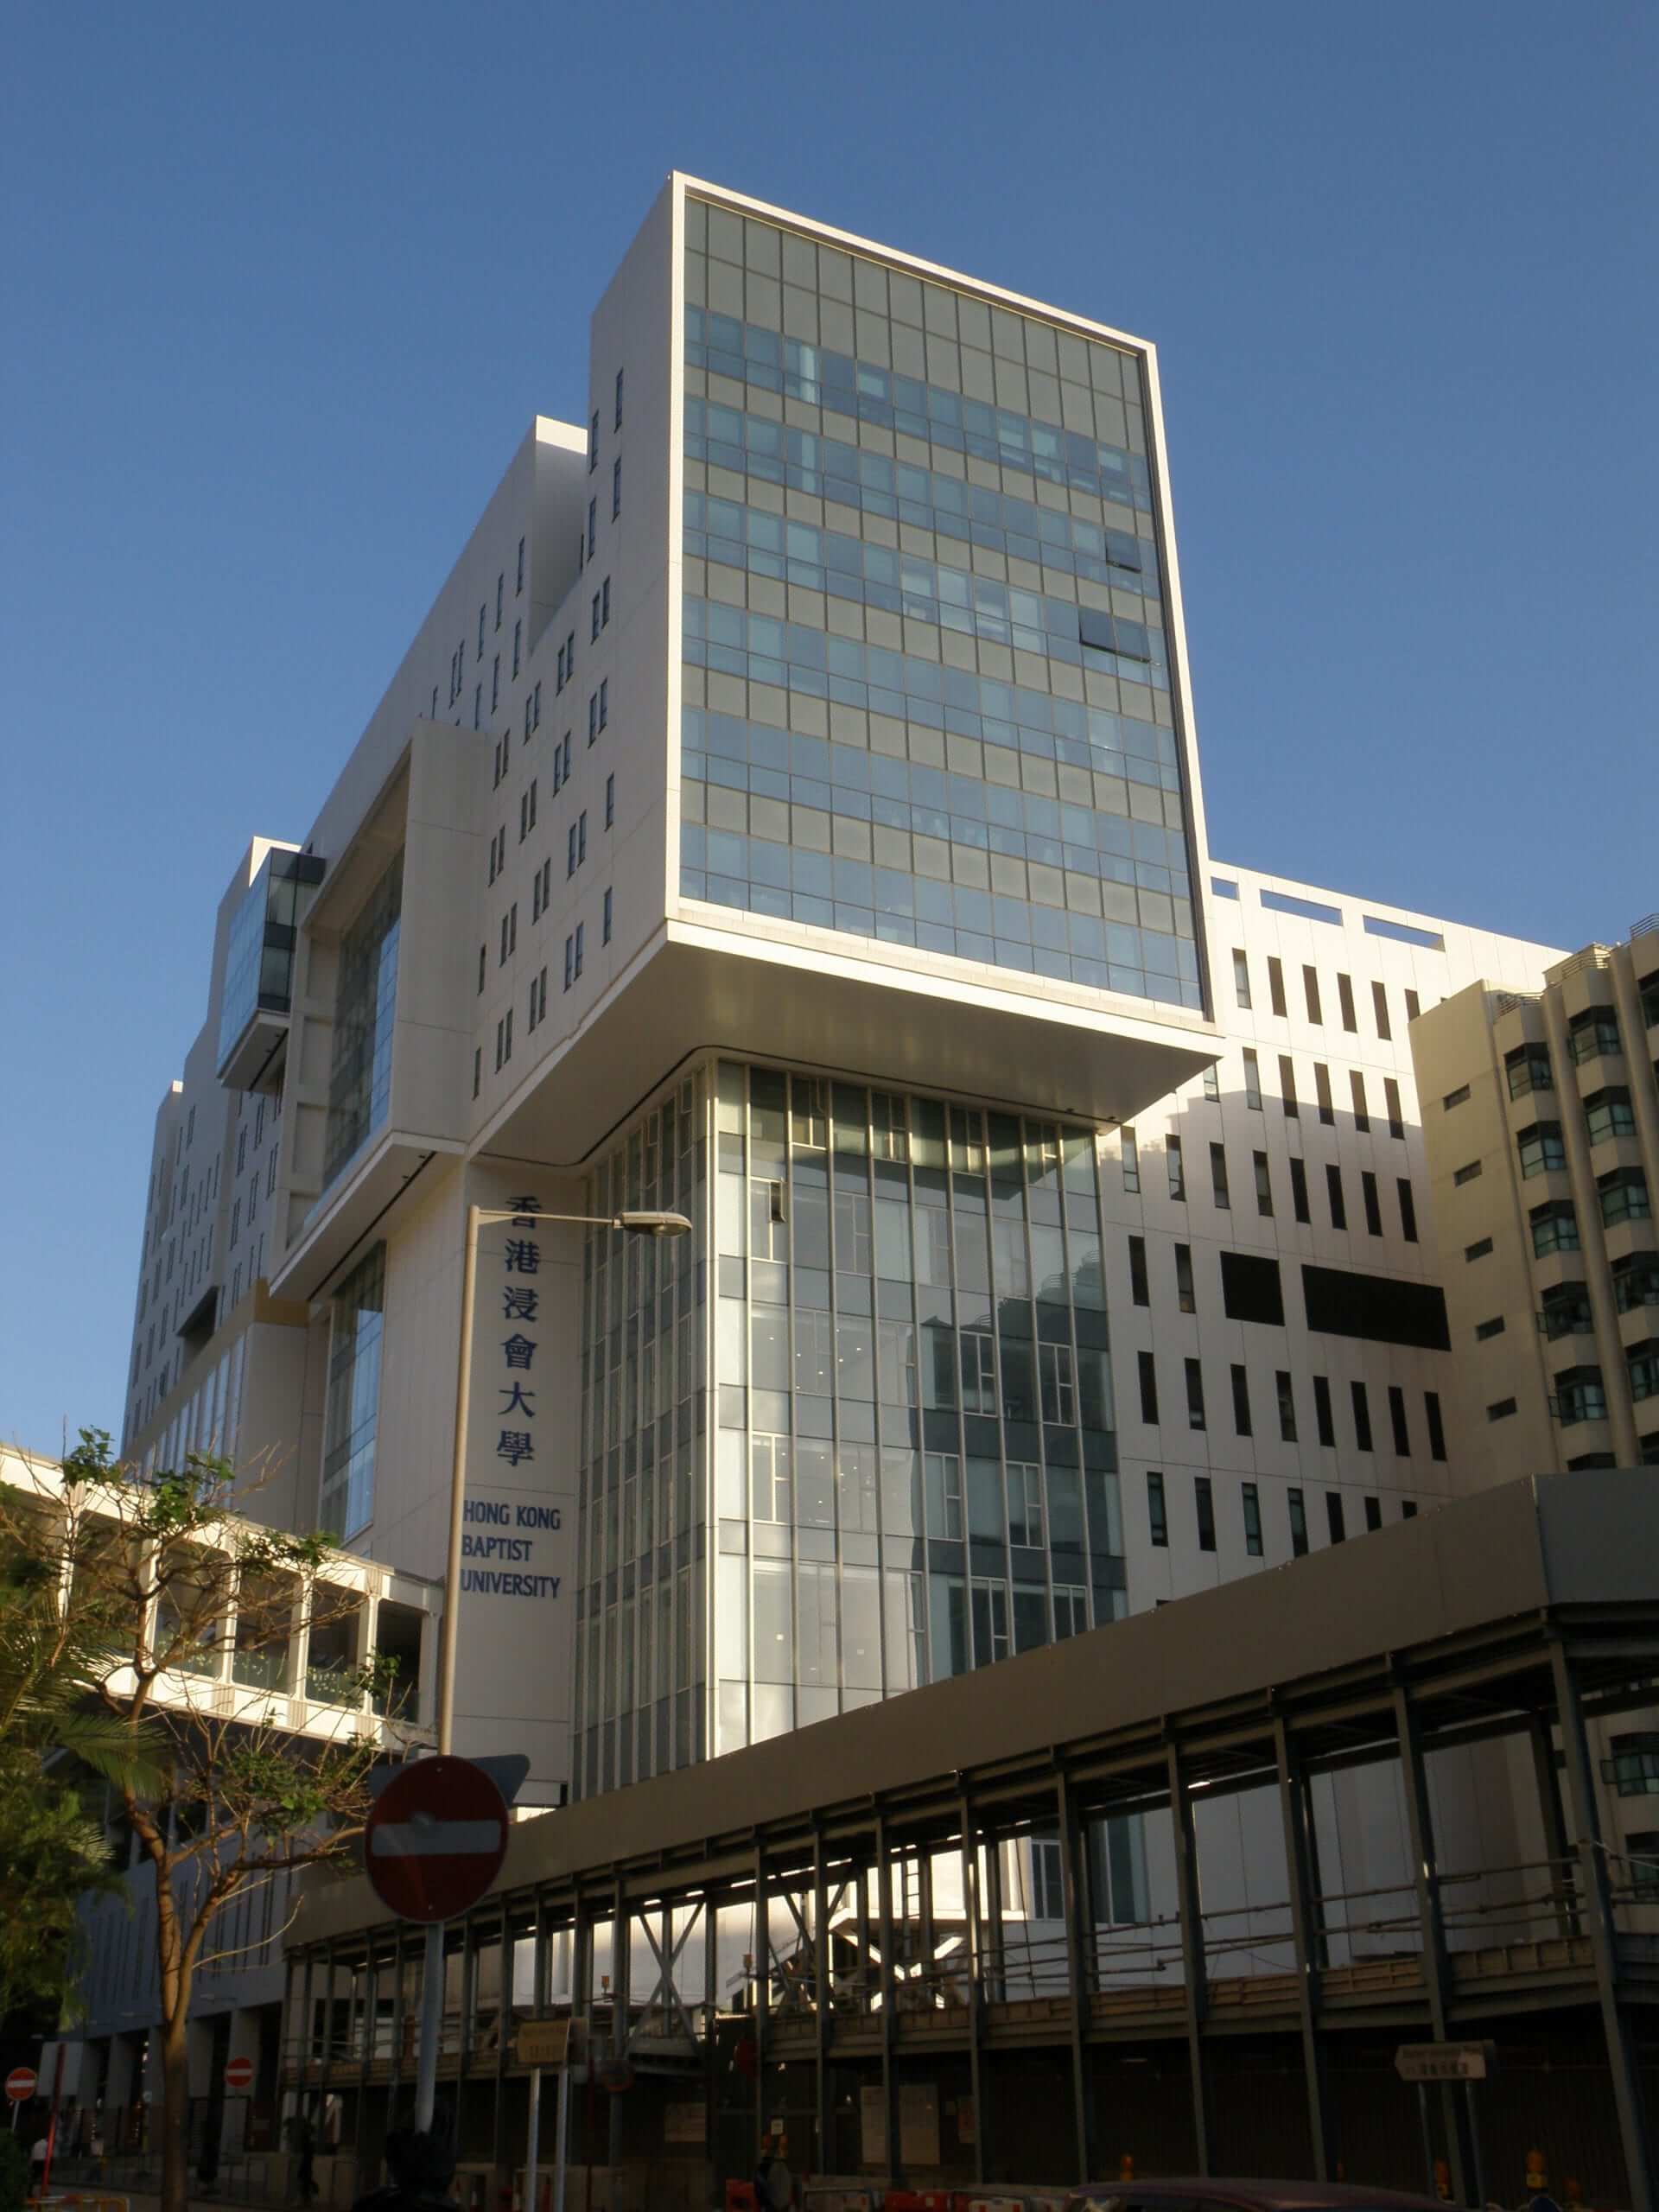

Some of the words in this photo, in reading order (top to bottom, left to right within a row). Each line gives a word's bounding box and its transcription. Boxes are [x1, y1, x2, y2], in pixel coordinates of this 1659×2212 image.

[496, 1196, 543, 1466] 香港浸會大學
[463, 1499, 510, 1525] HONG
[516, 1506, 561, 1529] KONG
[461, 1535, 533, 1561] BAPTIST
[460, 1568, 561, 1599] UNIVERSITY
